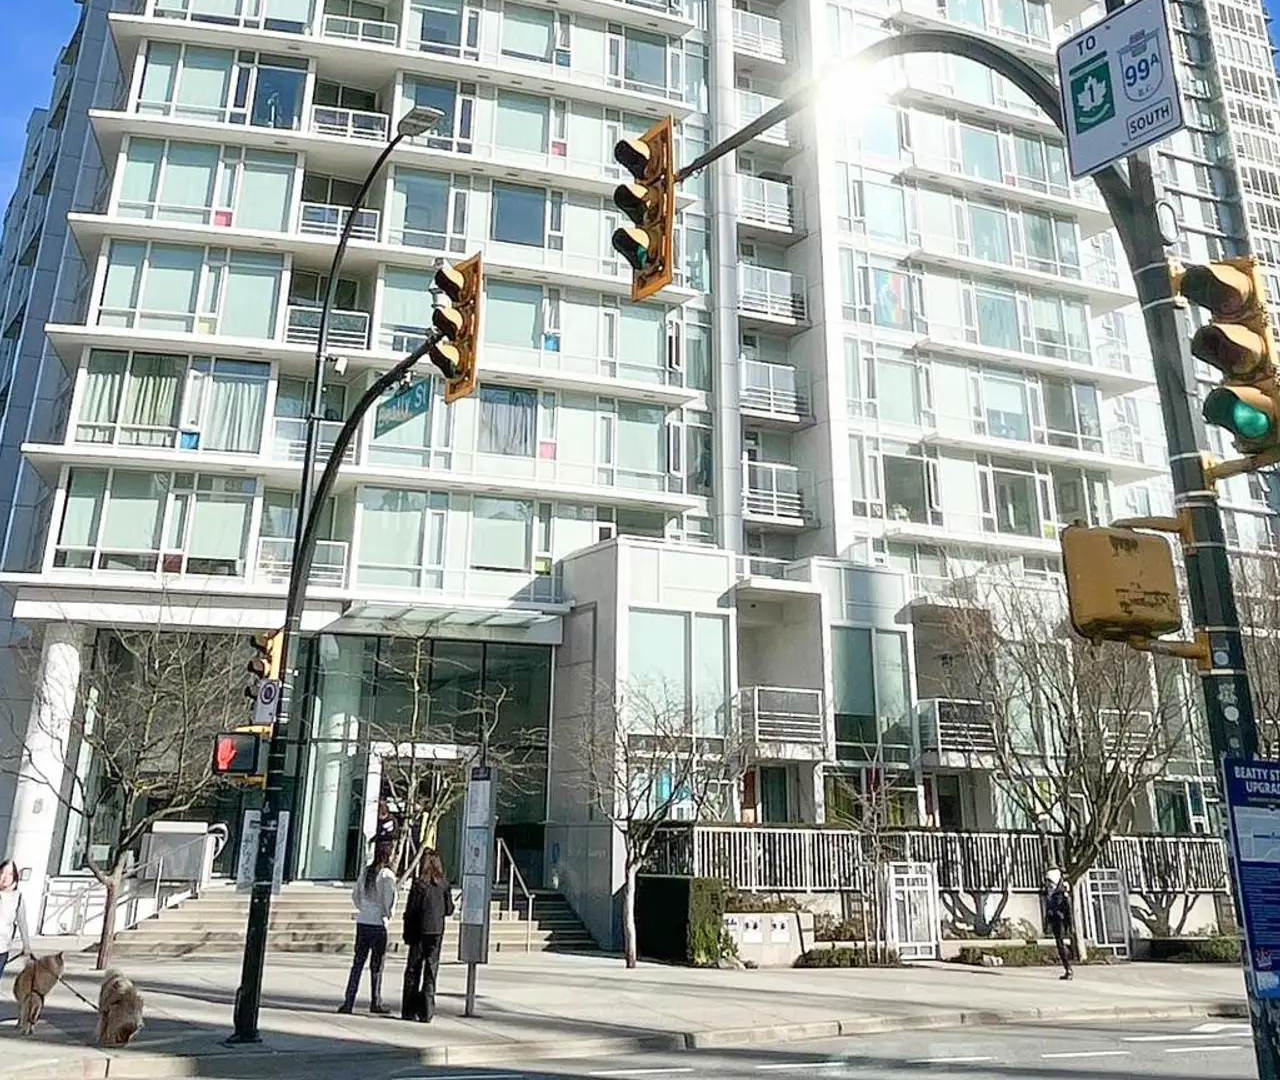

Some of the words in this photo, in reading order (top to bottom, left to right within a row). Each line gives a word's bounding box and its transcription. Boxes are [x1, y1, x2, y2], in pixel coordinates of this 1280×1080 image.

[1076, 35, 1096, 56] TO
[1088, 83, 1095, 103] 1
[1129, 104, 1170, 134] SOUTH
[1234, 765, 1268, 780] BEATTY
